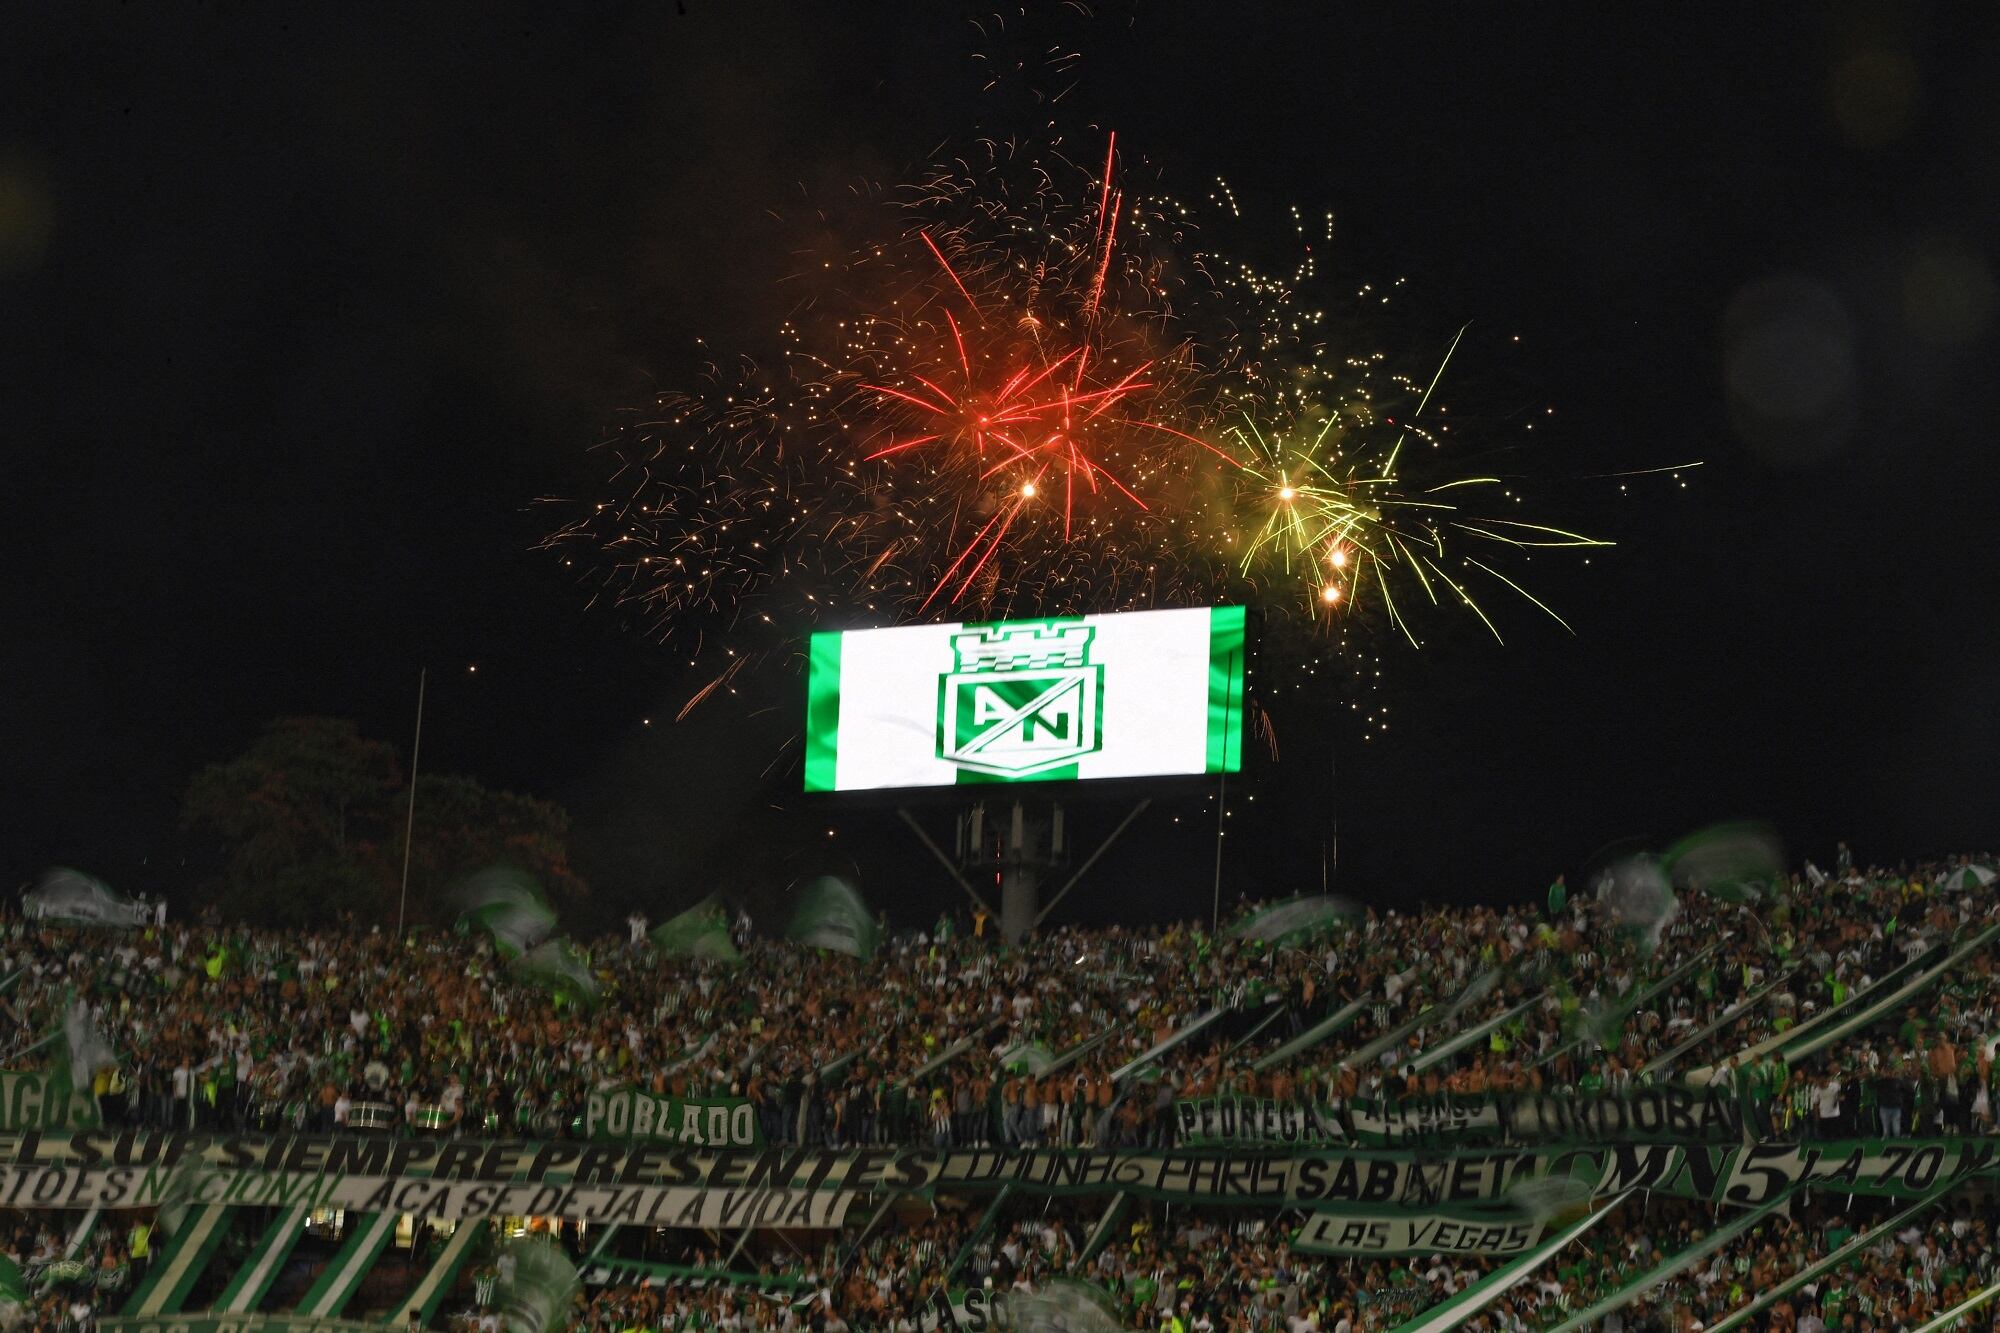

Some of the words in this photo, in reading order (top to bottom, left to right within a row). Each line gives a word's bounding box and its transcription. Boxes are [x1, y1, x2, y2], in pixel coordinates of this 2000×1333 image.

[587, 1090, 754, 1146] POBLADO
[215, 1134, 528, 1180] SIEMPRE
[525, 1142, 936, 1189] PRESENTES
[1869, 1143, 1946, 1191] 70
[461, 1186, 527, 1217] SE
[1313, 1220, 1392, 1249] LAS
[1407, 1218, 1534, 1251] VEGAS
